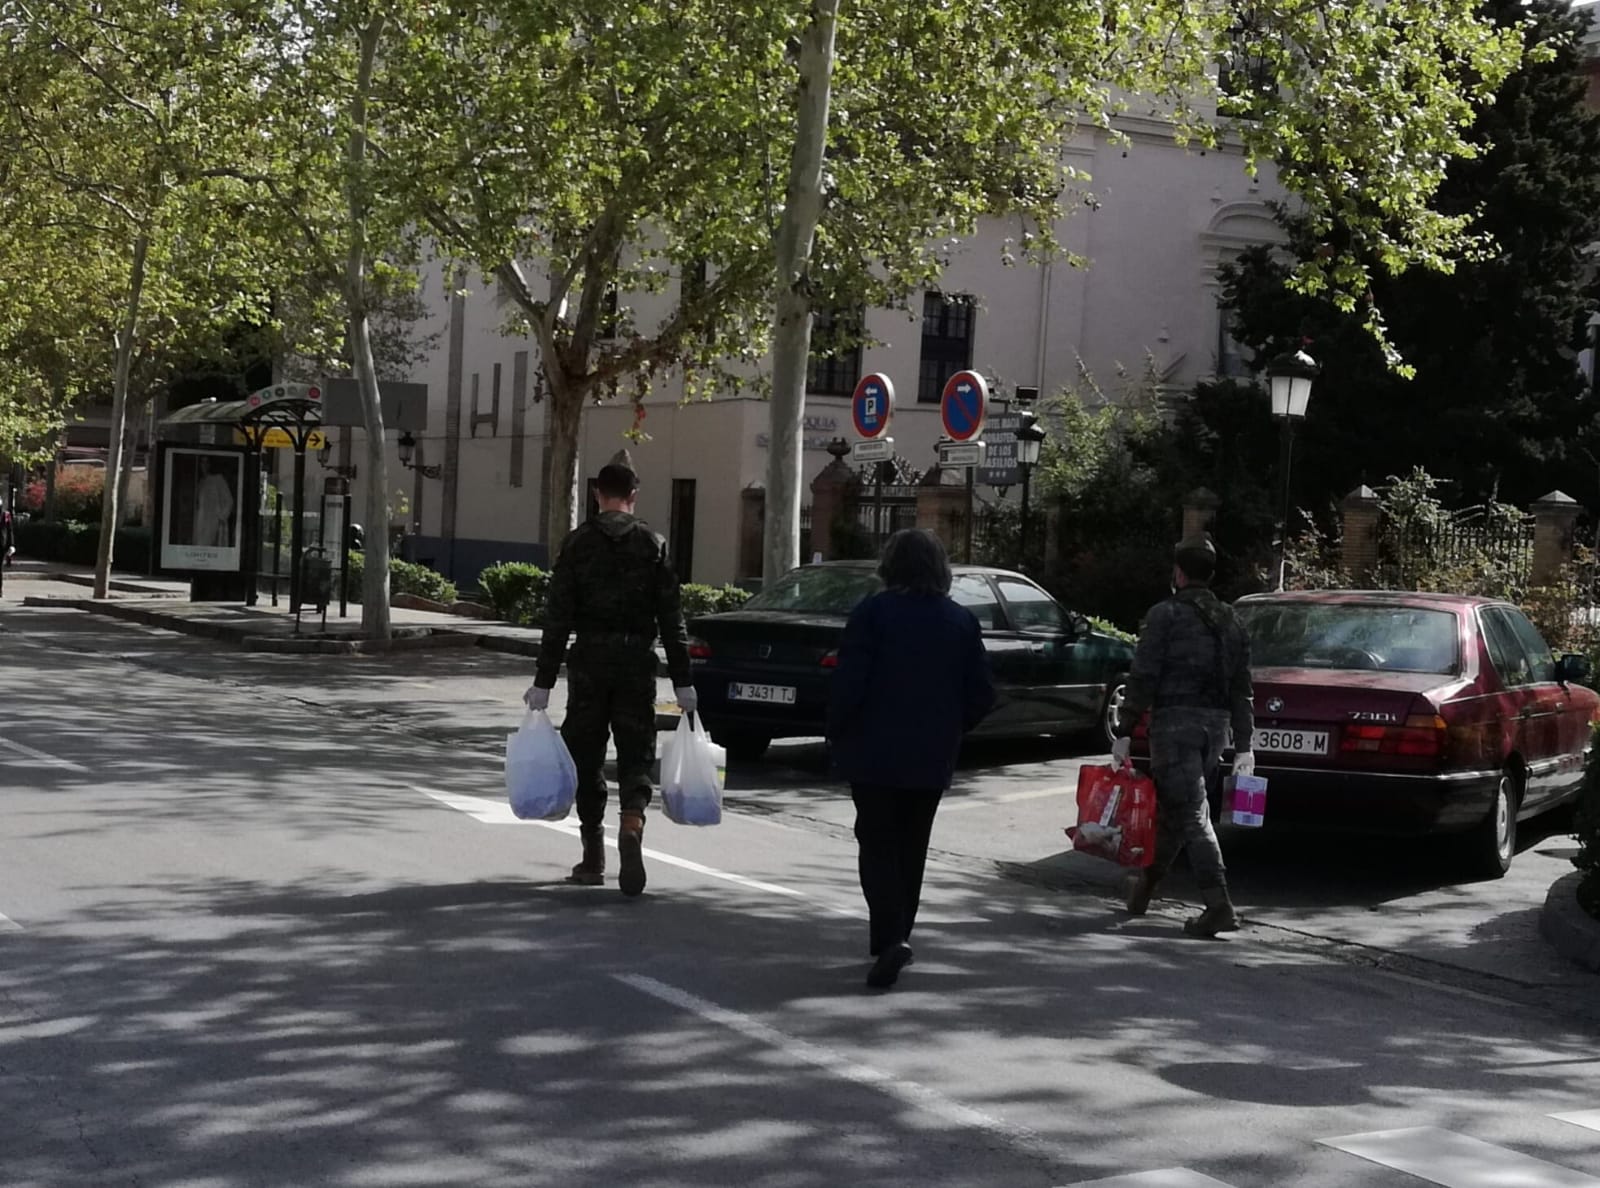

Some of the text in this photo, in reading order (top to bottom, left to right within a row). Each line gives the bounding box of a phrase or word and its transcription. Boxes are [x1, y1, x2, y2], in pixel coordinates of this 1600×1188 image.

[867, 399, 874, 413] P
[803, 416, 836, 430] OQUIA
[988, 445, 998, 456] DE
[999, 444, 1011, 456] LOS
[983, 457, 1018, 468] ASILIOS
[748, 686, 774, 700] 3431
[781, 688, 795, 702] TJ
[1347, 711, 1396, 721] 730i
